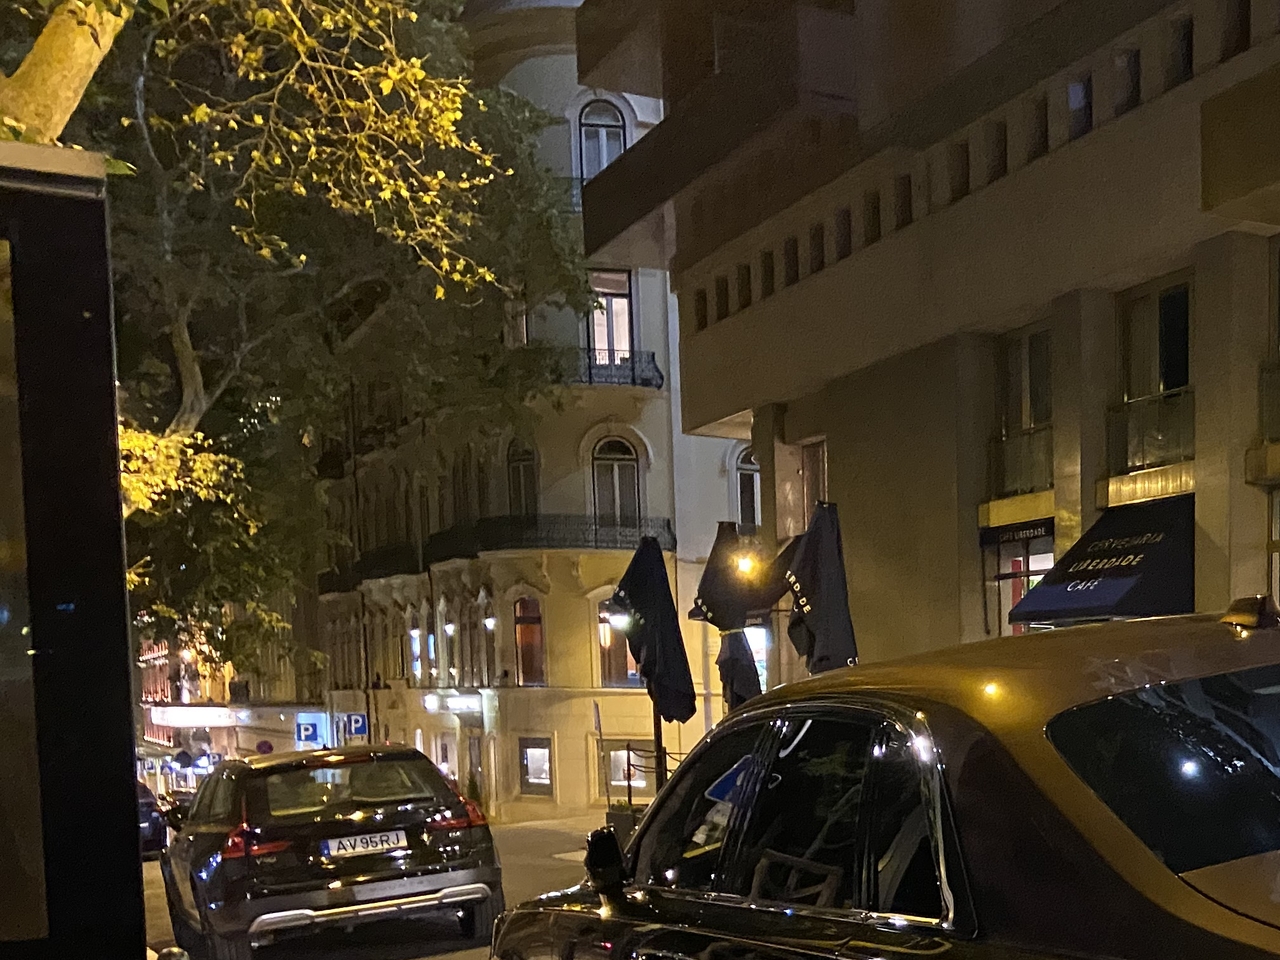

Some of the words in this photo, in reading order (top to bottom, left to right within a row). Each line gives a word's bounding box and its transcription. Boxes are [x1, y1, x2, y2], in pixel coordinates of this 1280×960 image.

[1068, 554, 1144, 573] LIBERDADE
[300, 724, 314, 739] P
[351, 715, 363, 732] P
